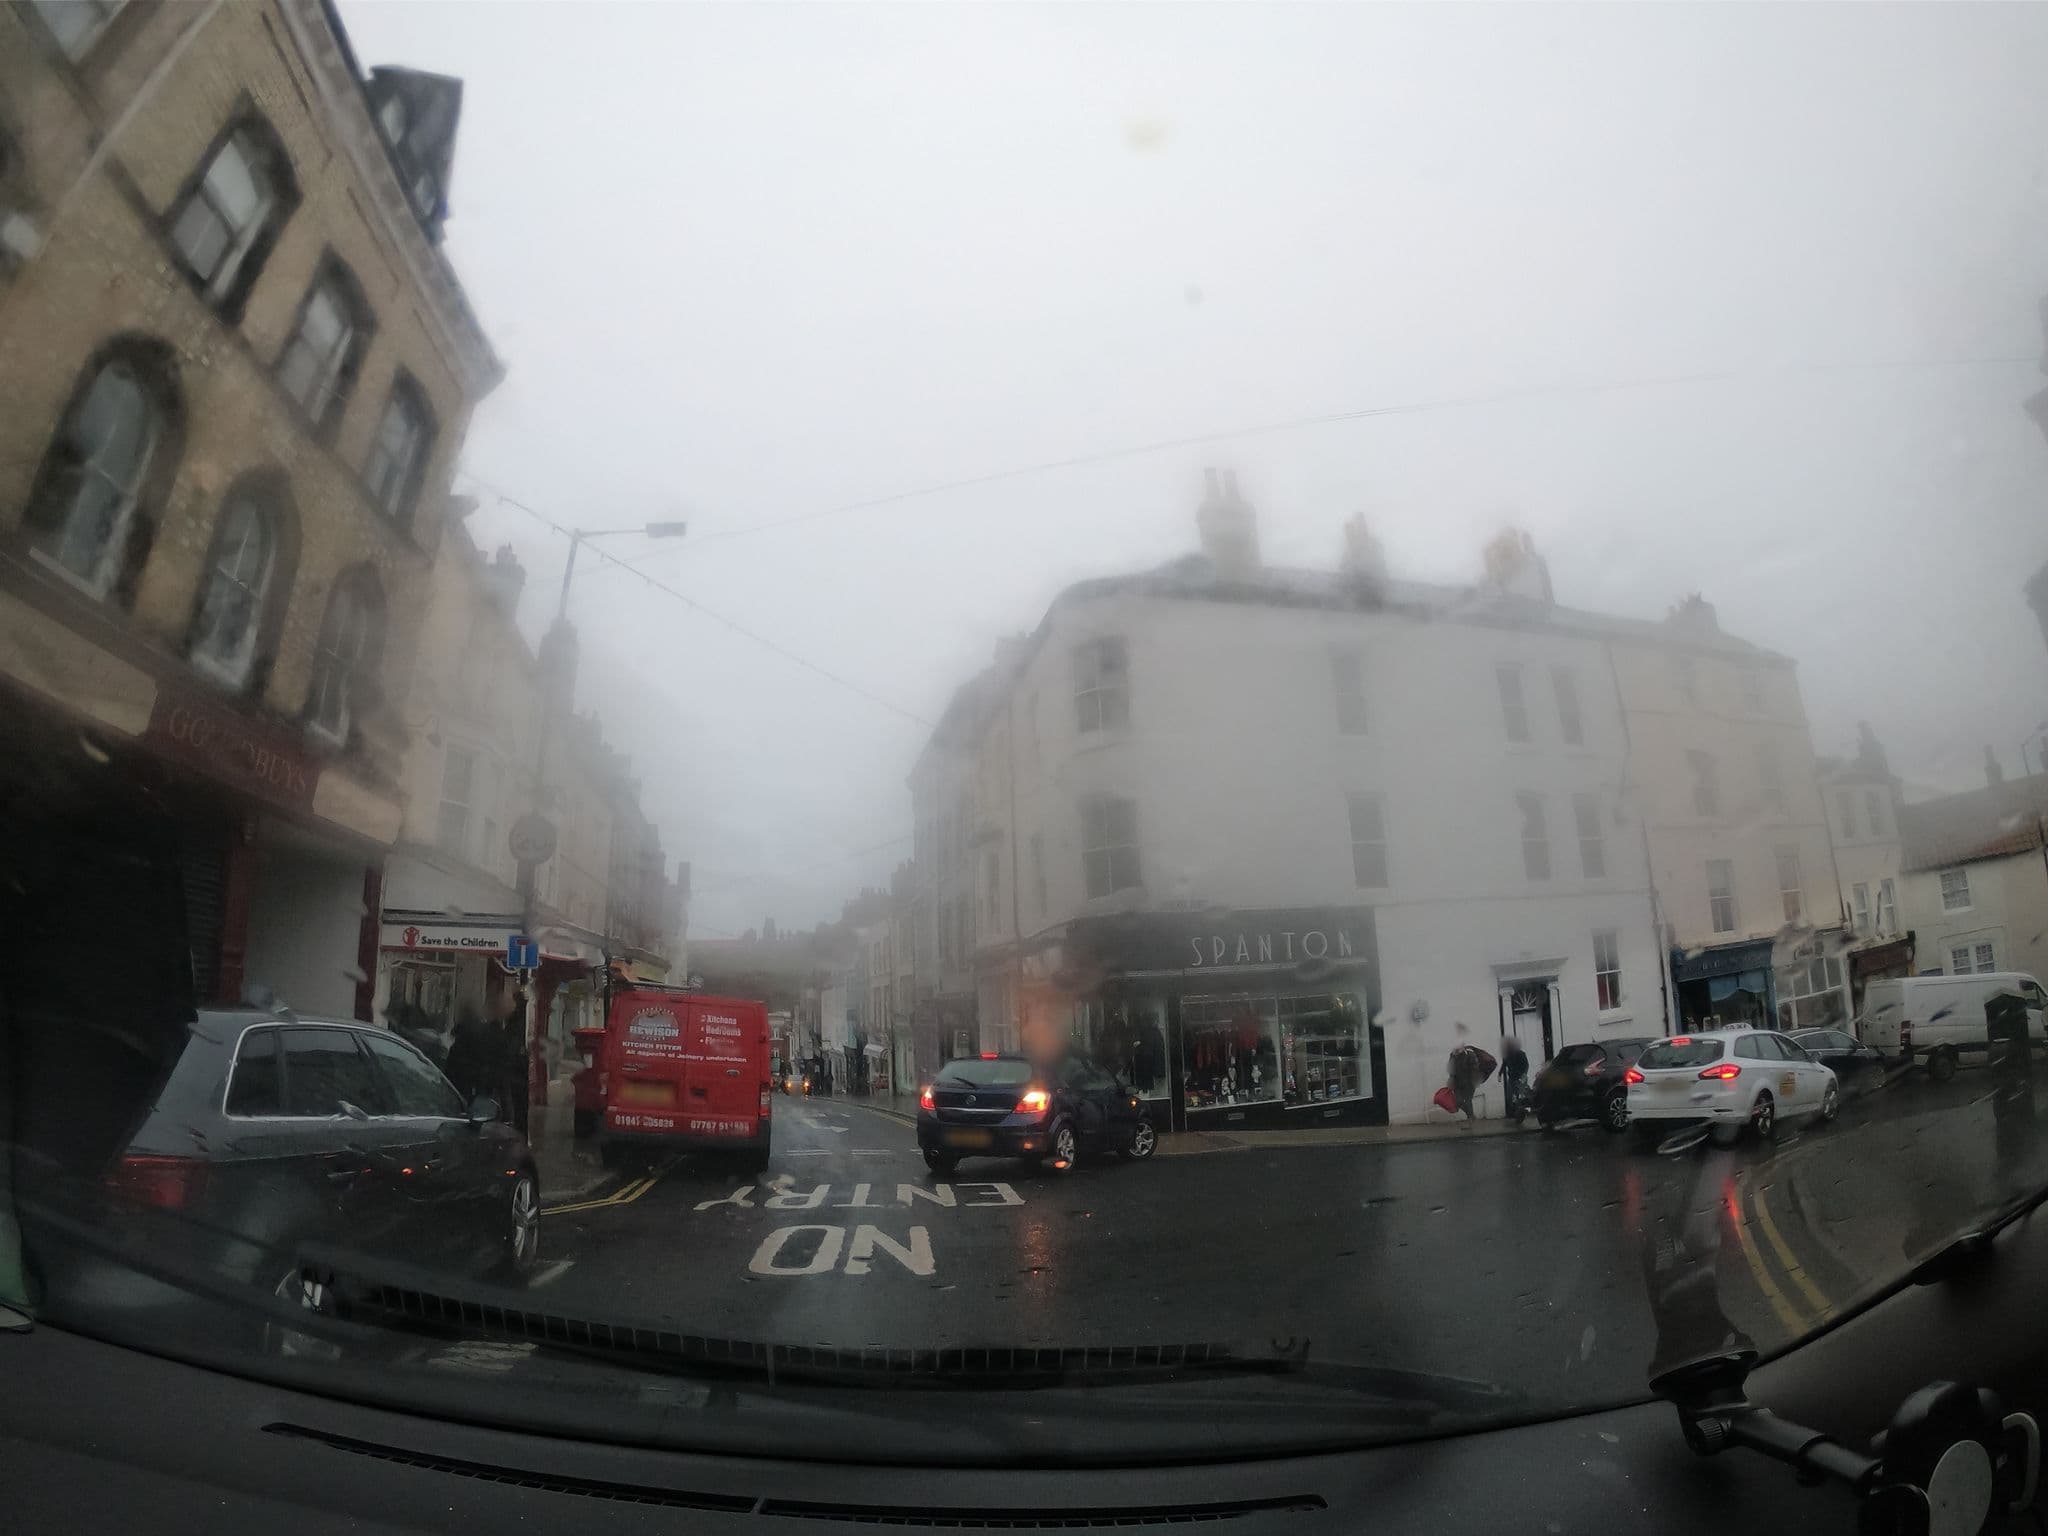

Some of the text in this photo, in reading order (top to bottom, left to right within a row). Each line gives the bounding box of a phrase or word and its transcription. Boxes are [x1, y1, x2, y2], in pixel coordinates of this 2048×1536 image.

[421, 936, 499, 948] Save the Children
[1191, 930, 1352, 966] SPANTON
[622, 1041, 682, 1051] KITCHEN FITTER
[706, 1055, 747, 1063] undertaken
[693, 1183, 1027, 1210] ENTRY
[749, 1224, 936, 1275] NO
